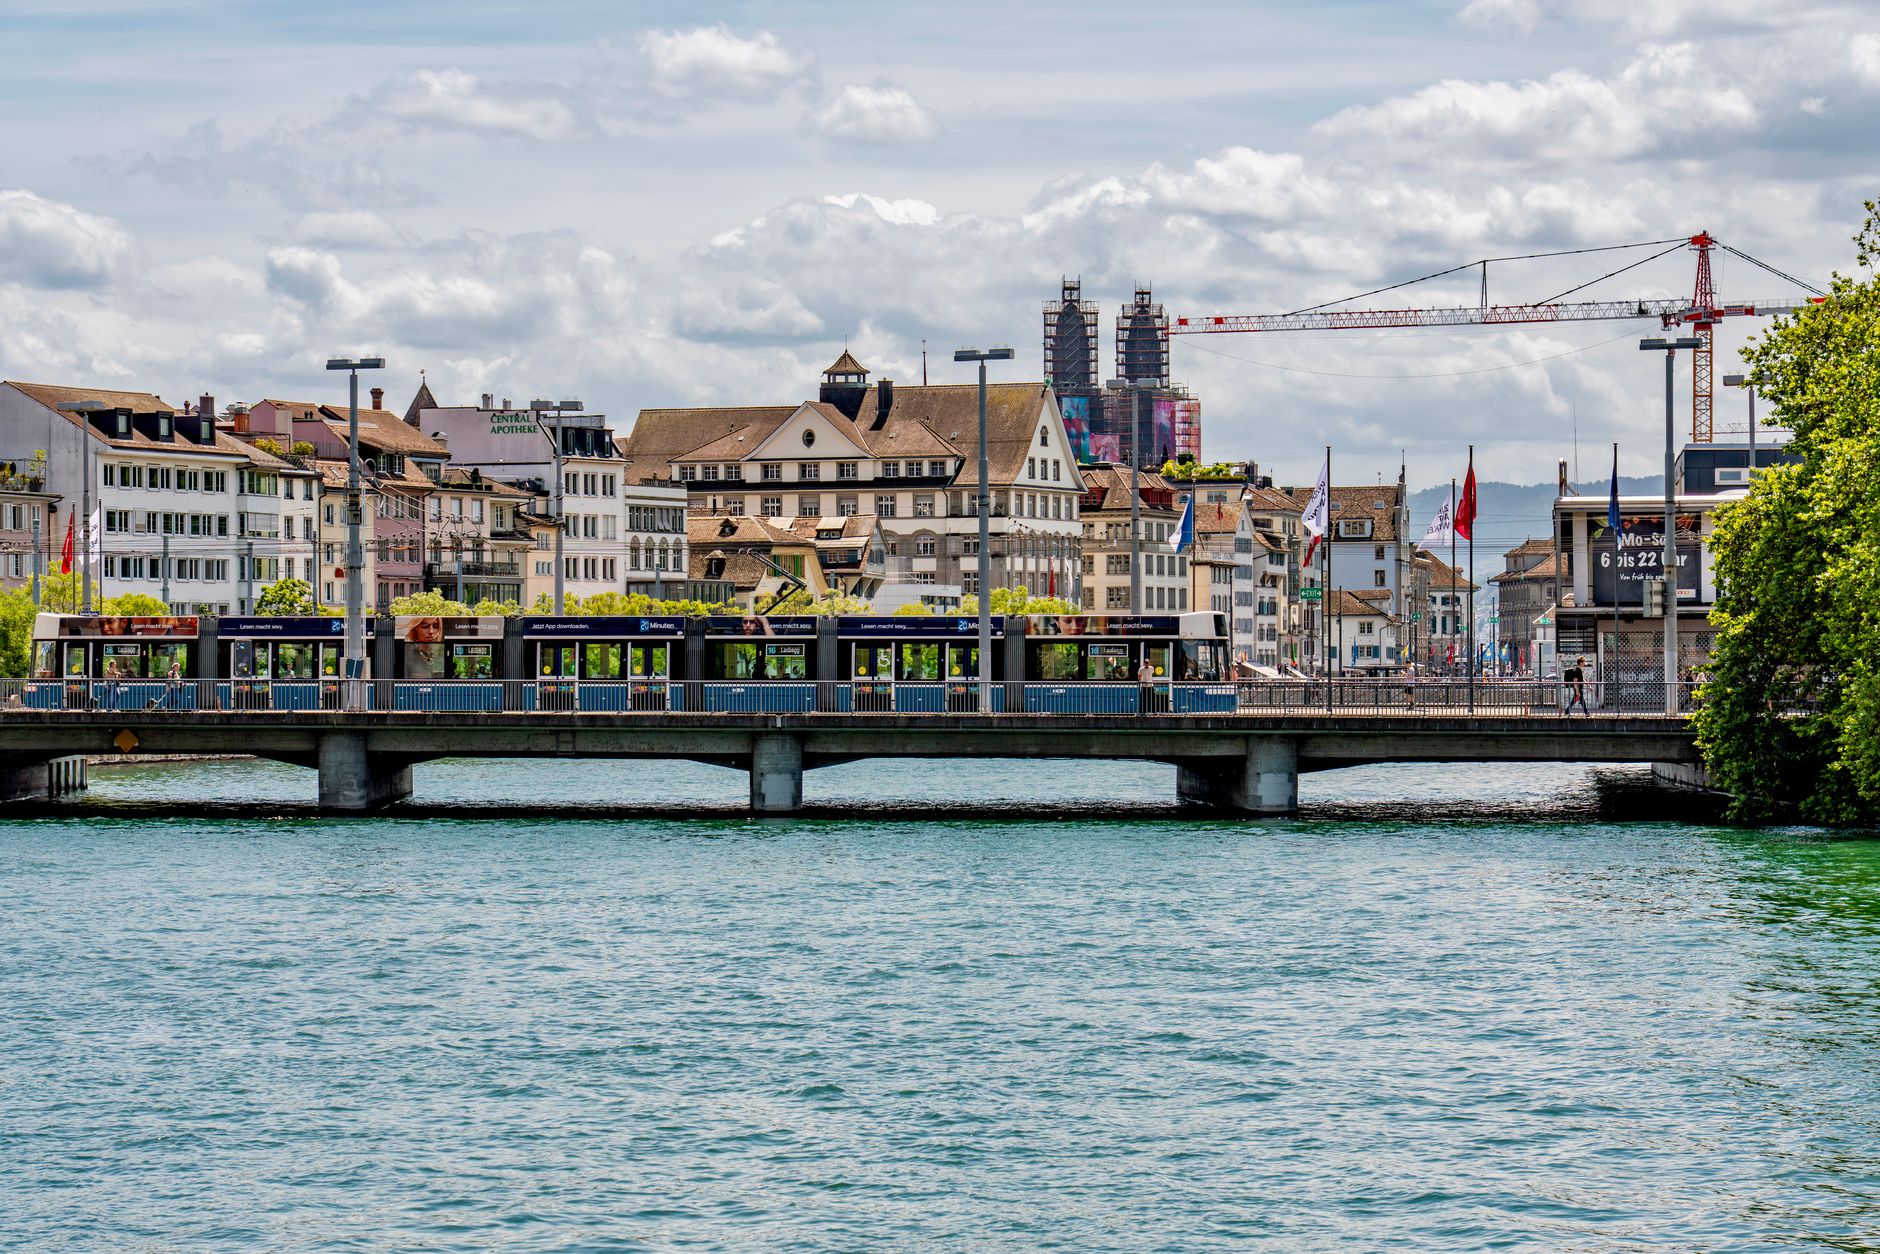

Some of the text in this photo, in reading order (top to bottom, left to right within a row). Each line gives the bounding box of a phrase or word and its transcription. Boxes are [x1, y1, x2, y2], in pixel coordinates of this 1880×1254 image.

[490, 414, 531, 423] CENTRAL
[490, 424, 538, 434] APOTHEKE
[1600, 552, 1611, 567] 6
[1637, 551, 1657, 567] 22
[332, 621, 341, 631] 20
[640, 620, 649, 631] 20
[958, 621, 968, 631] 20
